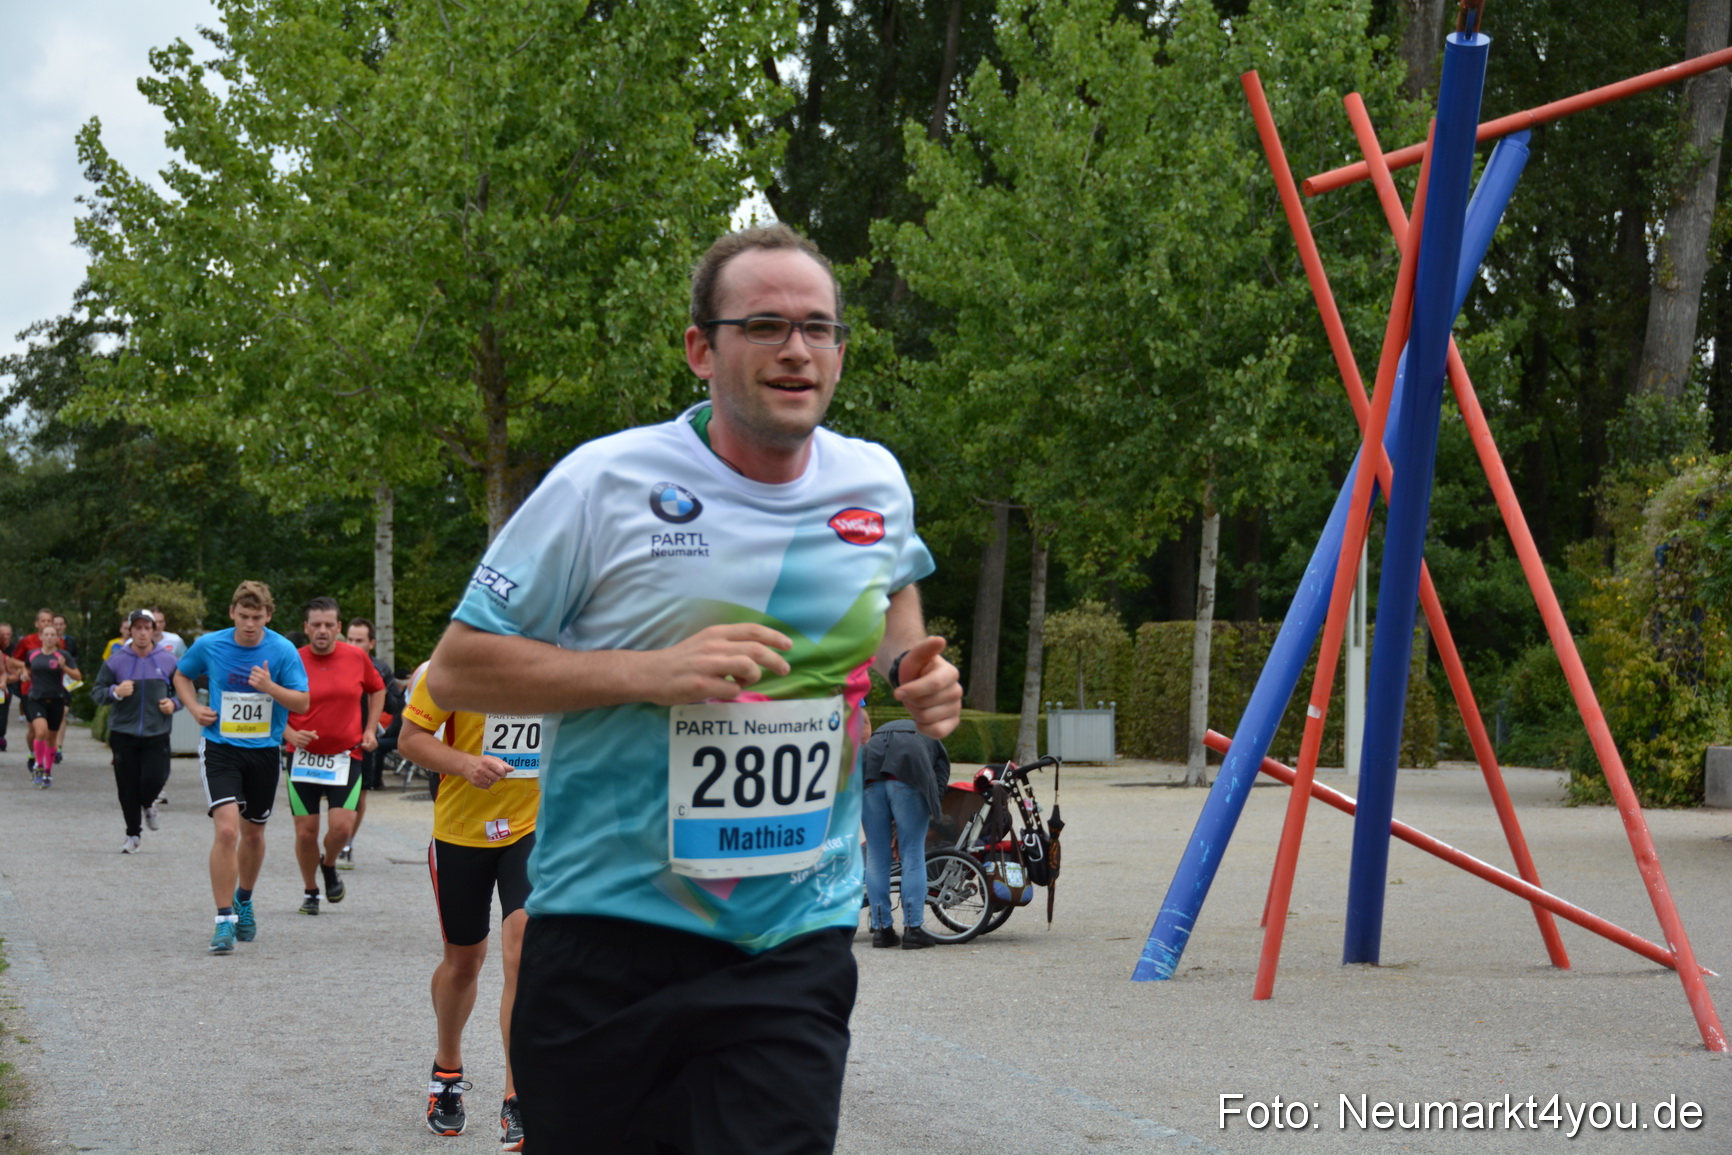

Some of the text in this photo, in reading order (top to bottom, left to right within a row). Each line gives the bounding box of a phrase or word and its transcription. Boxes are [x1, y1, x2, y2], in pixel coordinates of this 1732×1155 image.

[651, 532, 709, 547] PARTL
[651, 547, 710, 558] Neumarkt
[228, 673, 249, 686] RU
[232, 703, 263, 721] 204
[407, 704, 433, 722] oegl.de
[491, 722, 541, 749] 270
[676, 717, 823, 736] PARTL Neumarkt
[298, 751, 335, 769] 2605
[691, 740, 831, 808] 2802
[678, 805, 686, 816] C
[718, 824, 806, 852] Mathias
